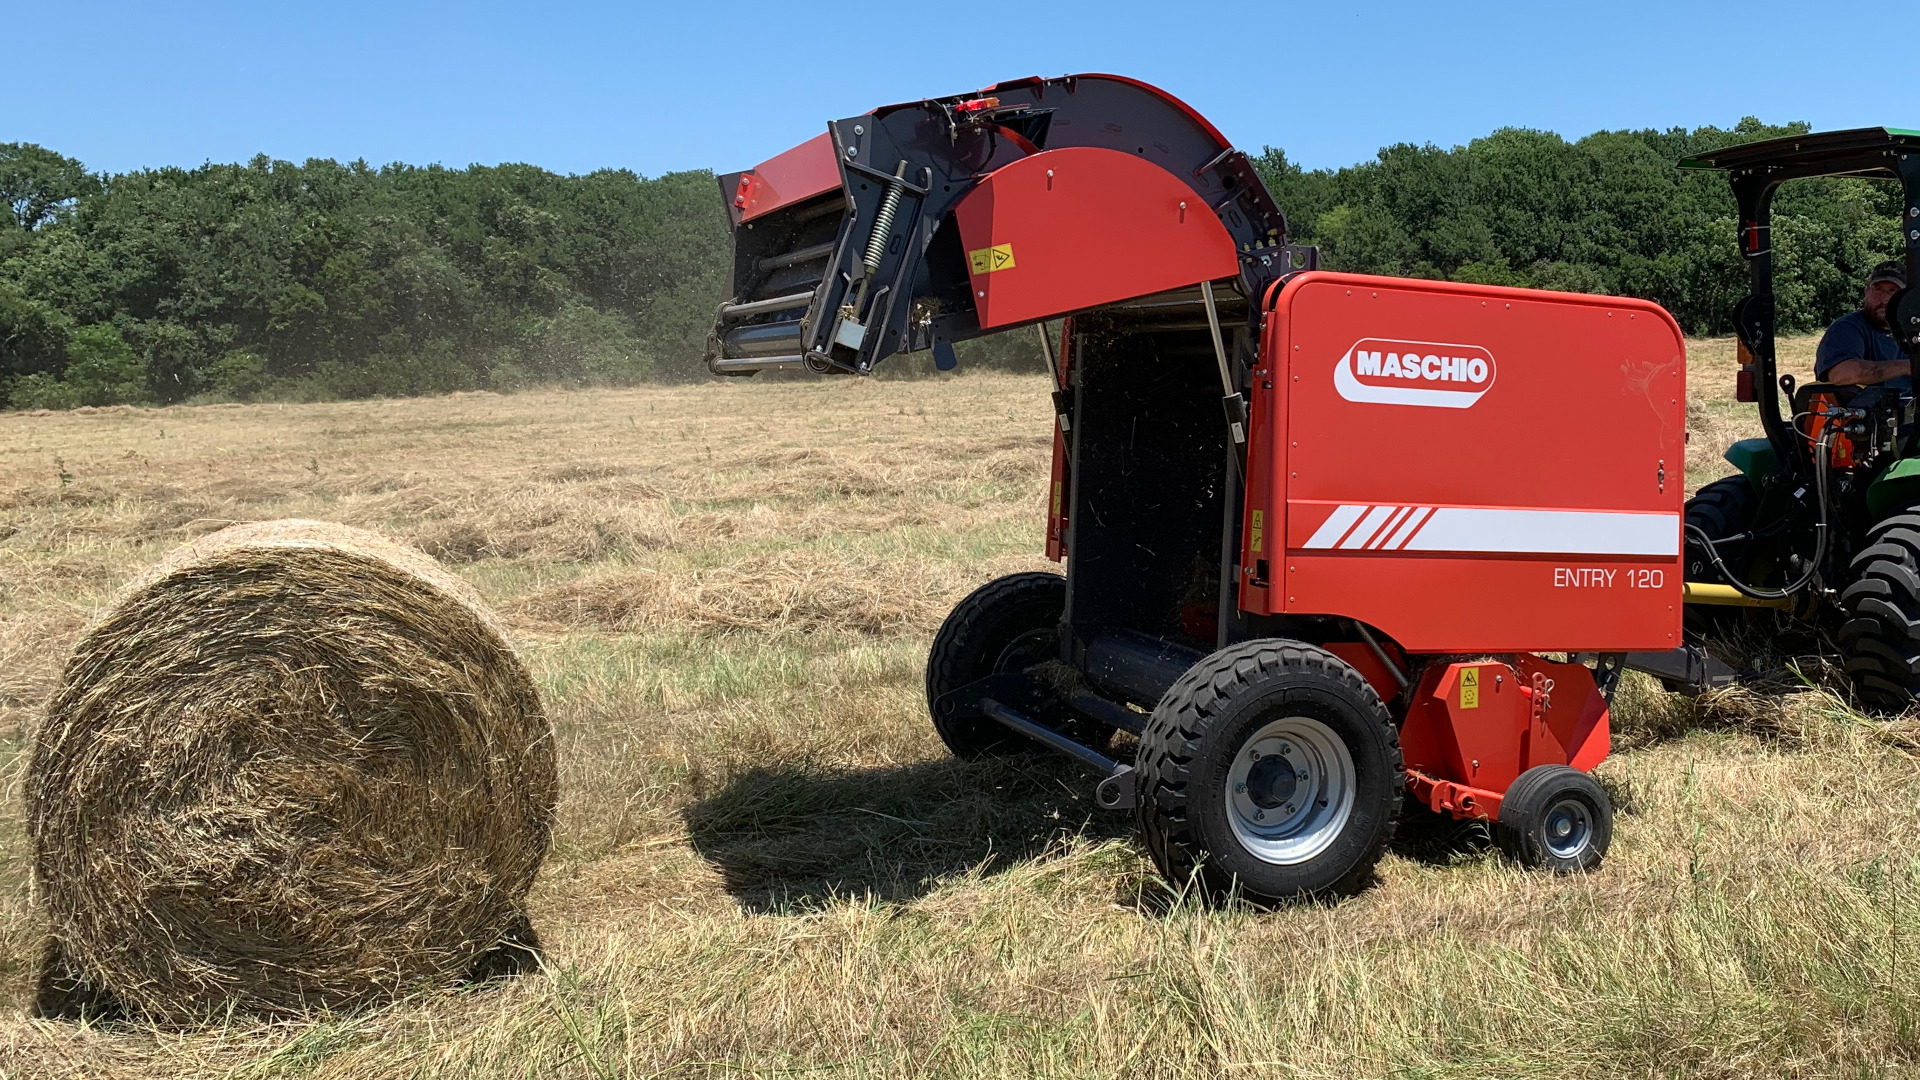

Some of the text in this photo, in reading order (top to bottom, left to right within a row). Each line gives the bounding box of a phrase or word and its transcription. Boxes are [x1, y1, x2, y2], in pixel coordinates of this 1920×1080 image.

[1357, 350, 1488, 383] MASCHIO
[1554, 567, 1664, 588] ENTRY 120
